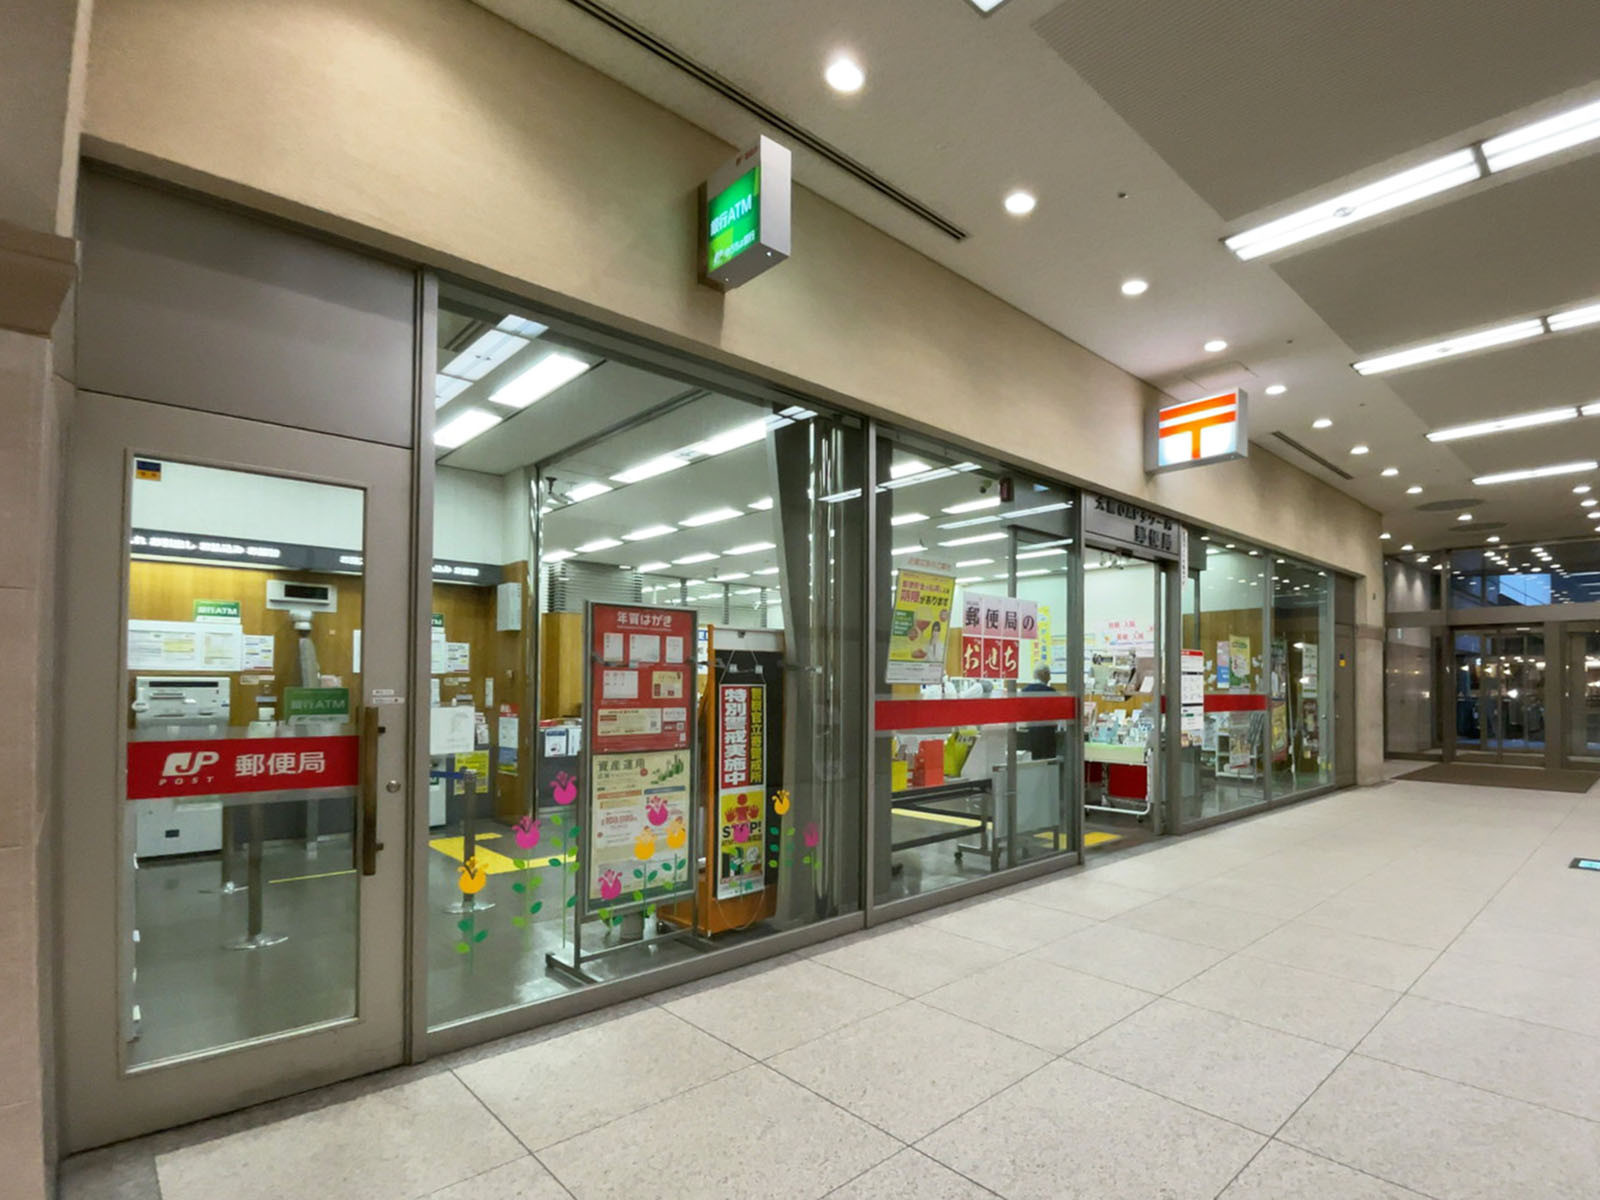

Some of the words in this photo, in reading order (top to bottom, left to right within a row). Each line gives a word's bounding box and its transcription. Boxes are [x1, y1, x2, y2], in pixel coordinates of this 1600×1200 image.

[617, 610, 673, 628] 年賀はがき
[965, 606, 1035, 632] 郵便局の
[964, 643, 1017, 671] おせち
[235, 751, 326, 777] 郵便局
[158, 776, 214, 786] POST
[722, 820, 761, 838] SP!
